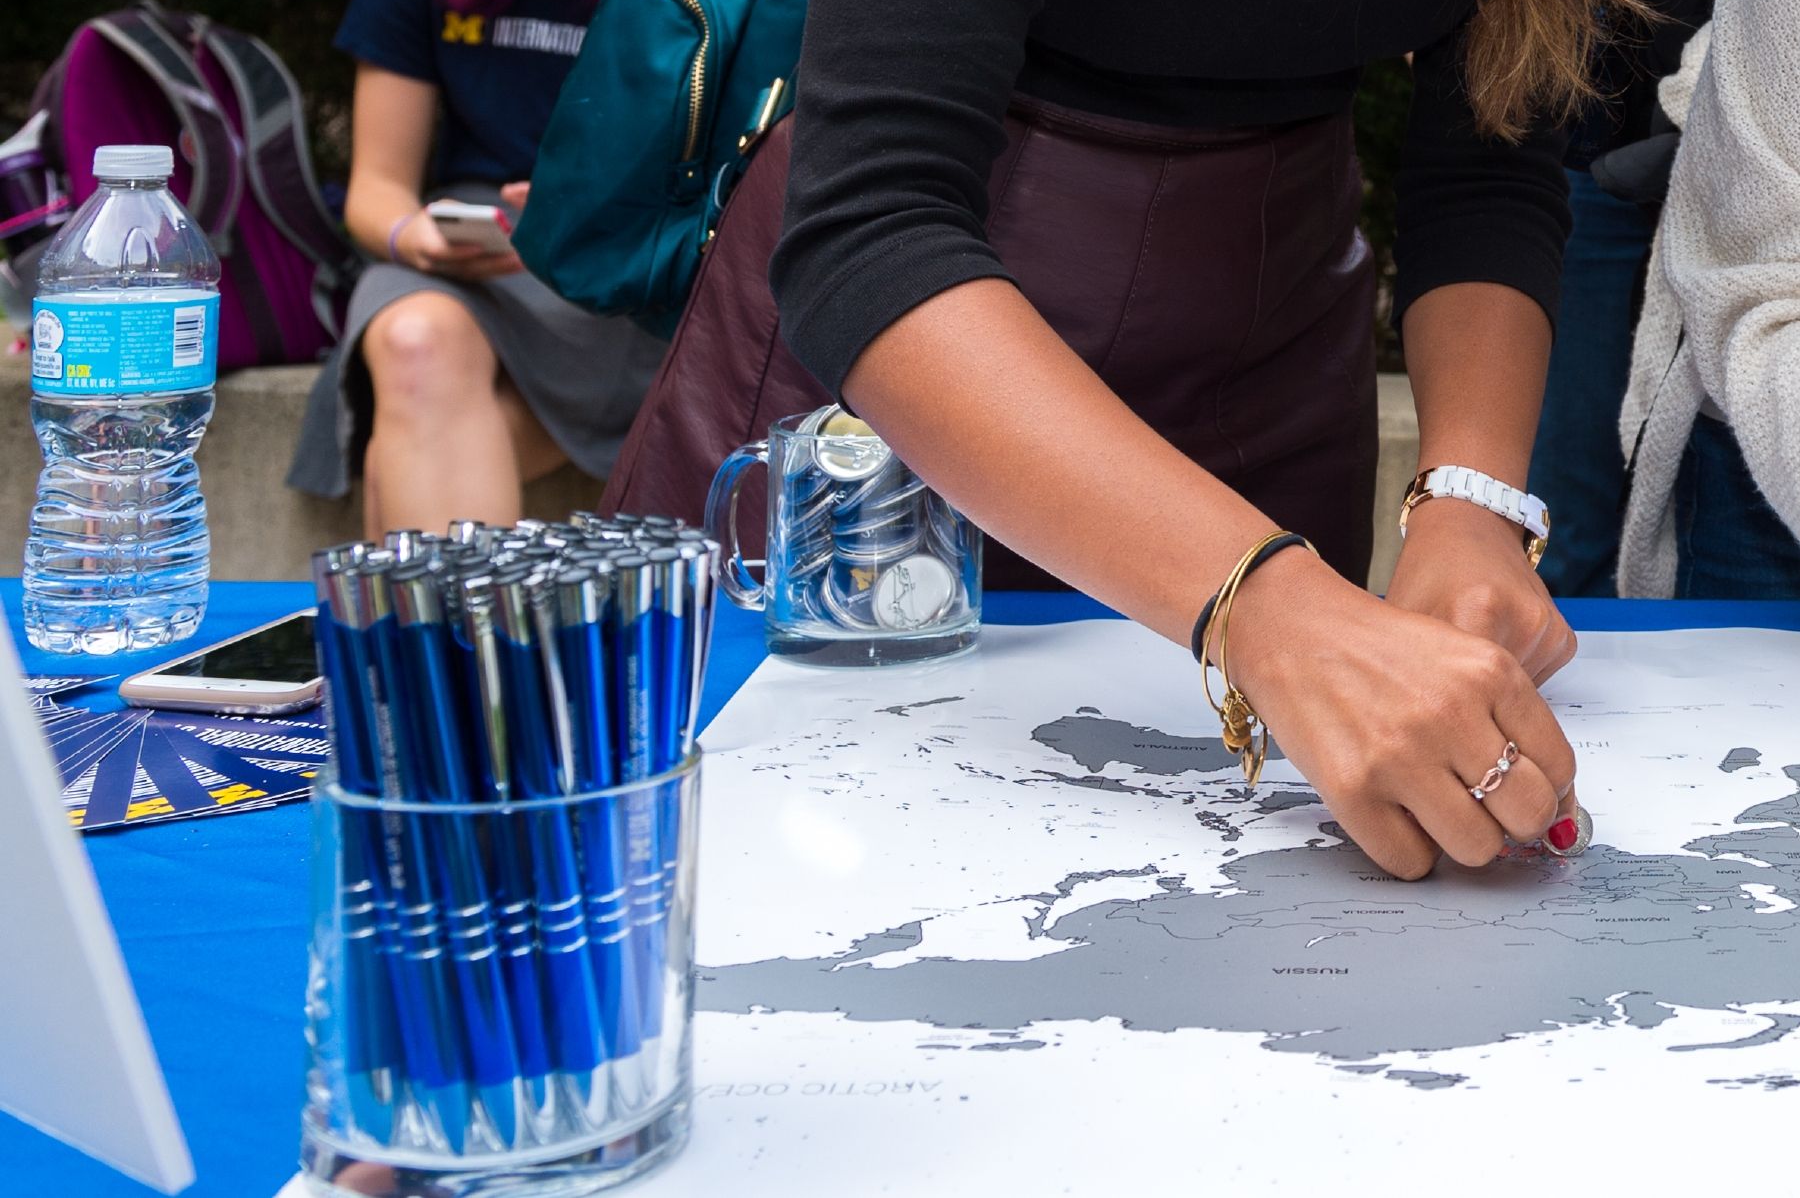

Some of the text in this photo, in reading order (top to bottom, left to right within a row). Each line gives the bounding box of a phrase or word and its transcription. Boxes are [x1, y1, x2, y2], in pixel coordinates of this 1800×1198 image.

[442, 11, 484, 44] M
[1272, 967, 1349, 975] RUSSIA
[800, 1080, 943, 1097] ARCTIC
